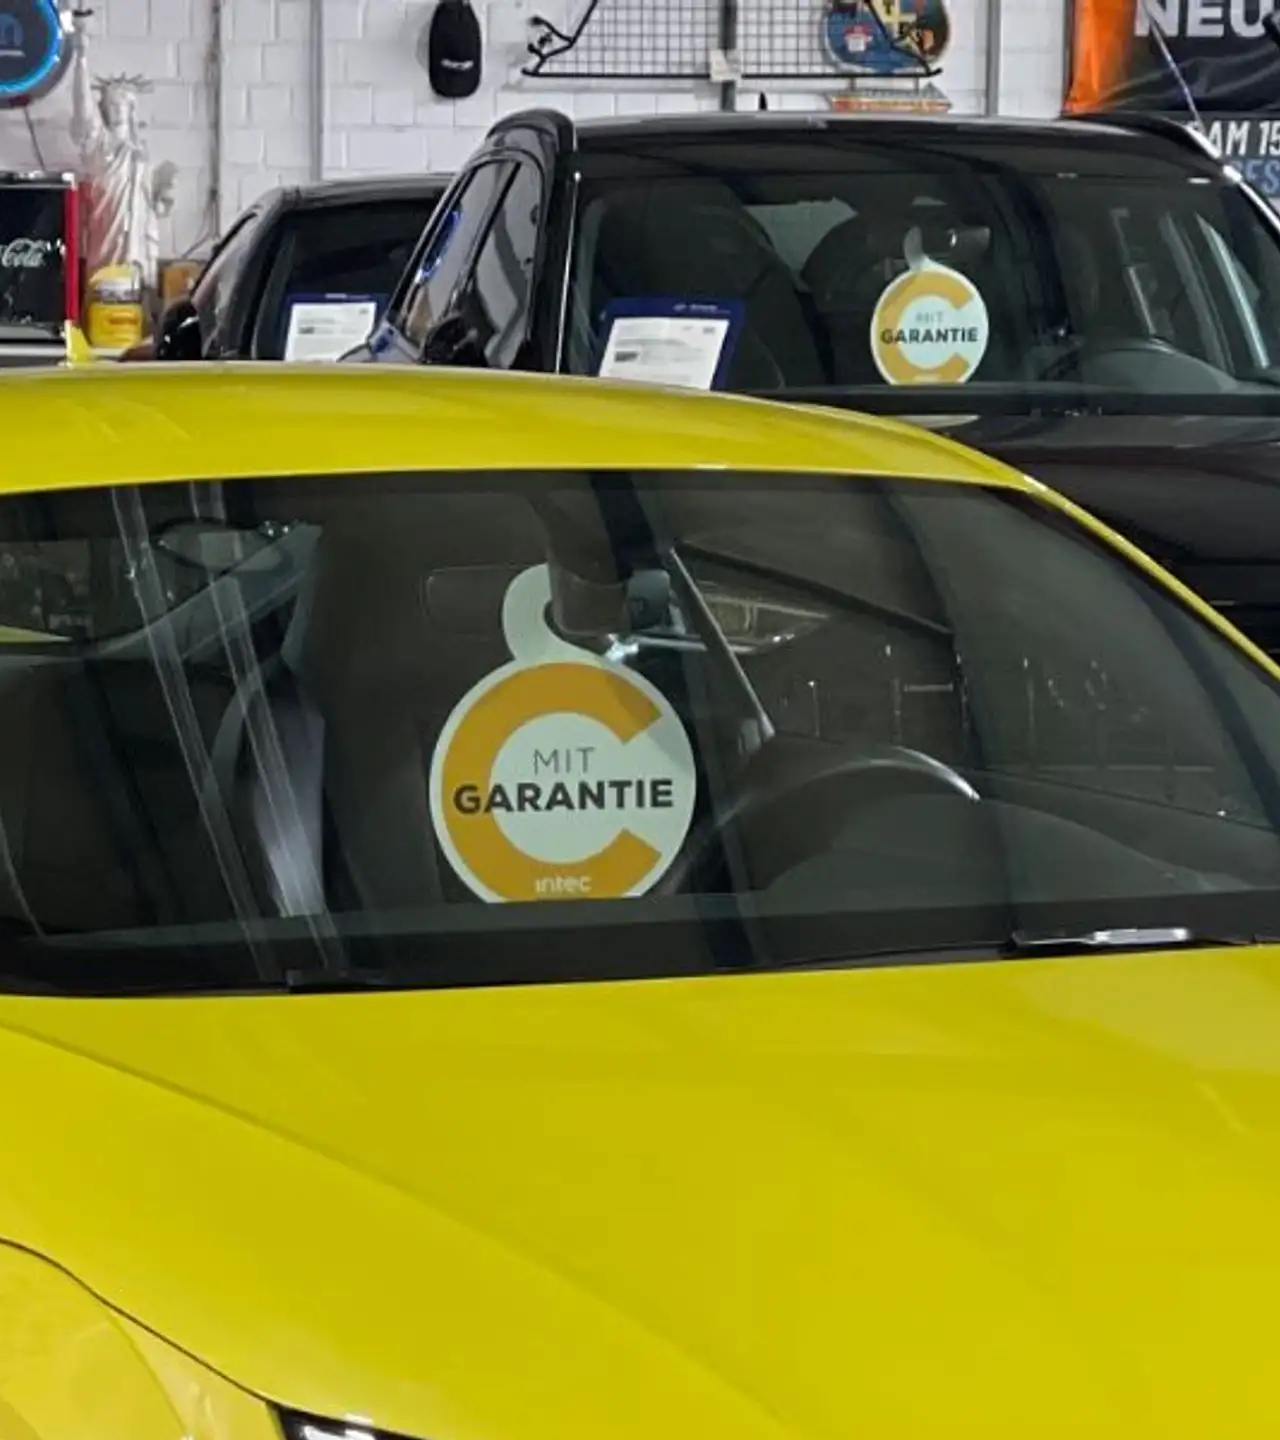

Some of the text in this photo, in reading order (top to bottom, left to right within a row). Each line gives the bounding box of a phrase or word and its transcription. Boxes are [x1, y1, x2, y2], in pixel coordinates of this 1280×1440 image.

[1192, 120, 1250, 155] AM
[880, 326, 979, 344] GARANTIE
[532, 747, 596, 776] MIT
[453, 779, 675, 815] GARANTIE
[535, 875, 592, 894] intec
